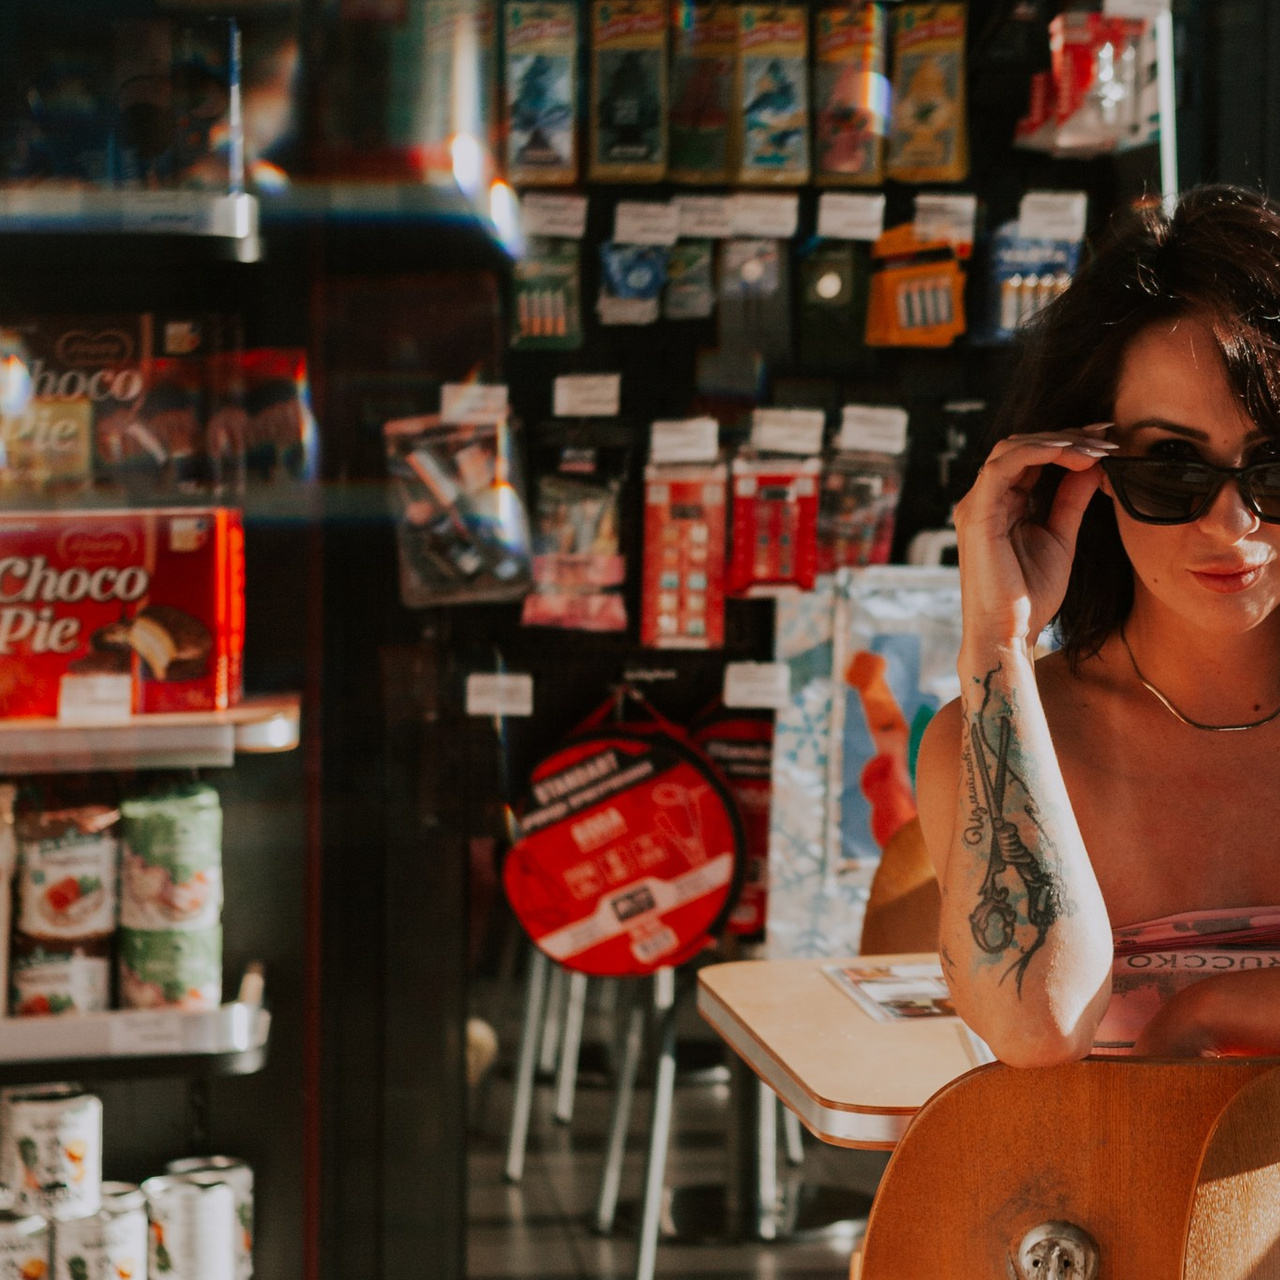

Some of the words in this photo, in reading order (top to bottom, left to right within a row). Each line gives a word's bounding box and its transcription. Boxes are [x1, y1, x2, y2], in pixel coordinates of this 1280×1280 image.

[22, 358, 142, 401] hoco
[0, 555, 148, 603] Choco
[0, 605, 80, 654] Pie
